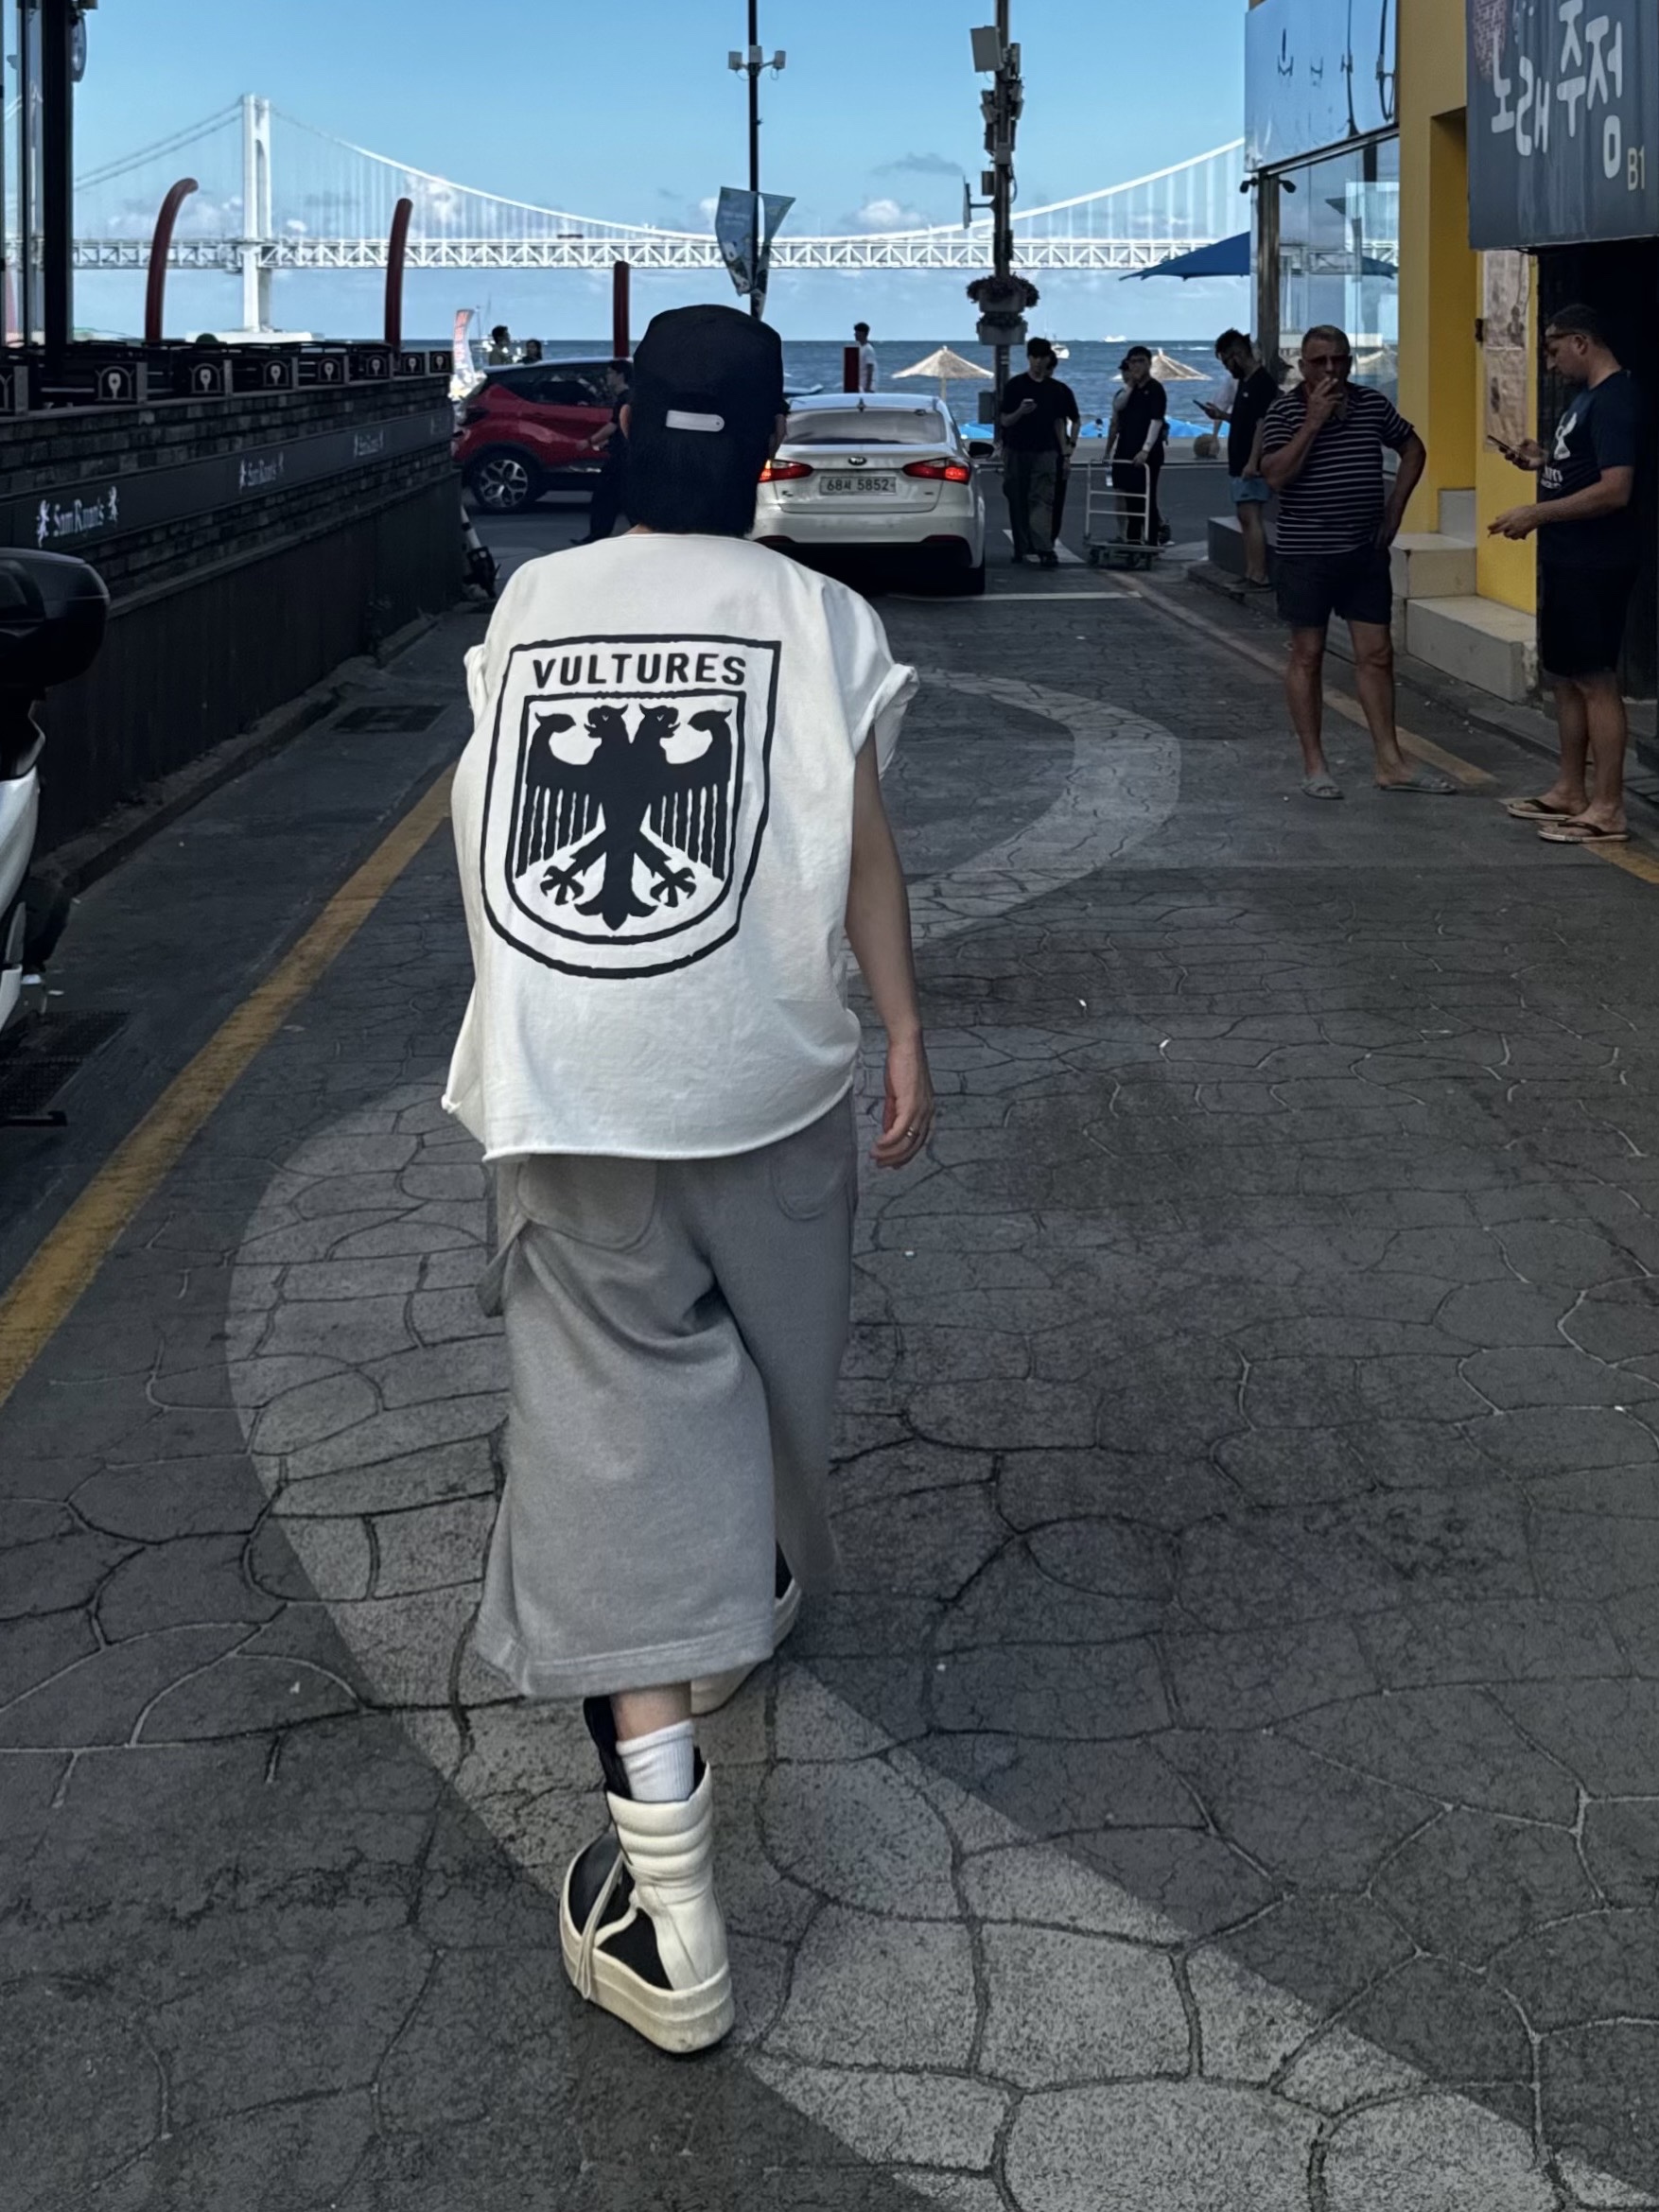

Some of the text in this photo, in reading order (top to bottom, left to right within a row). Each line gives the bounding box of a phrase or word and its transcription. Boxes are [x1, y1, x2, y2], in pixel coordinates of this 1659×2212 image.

[1627, 146, 1646, 191] B1
[857, 479, 890, 492] 5852
[533, 653, 746, 689] VULTURES
